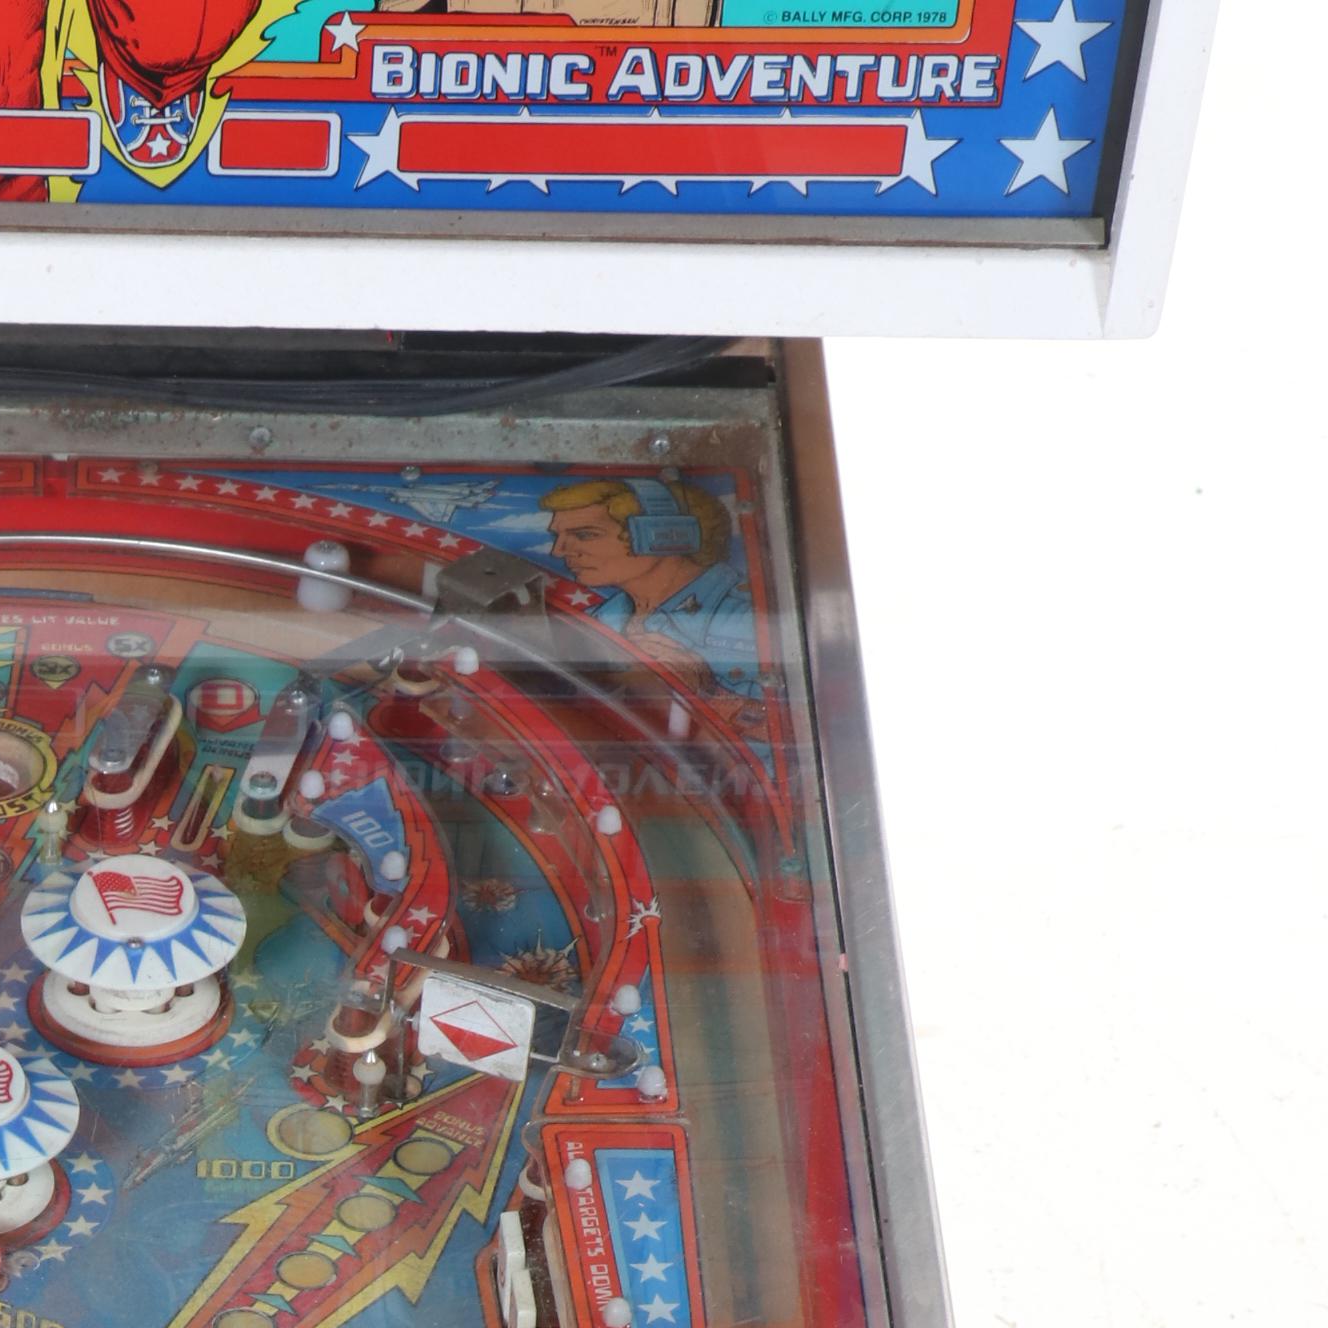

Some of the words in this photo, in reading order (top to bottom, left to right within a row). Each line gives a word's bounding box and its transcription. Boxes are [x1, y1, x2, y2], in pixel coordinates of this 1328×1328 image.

[781, 11, 826, 23] BALLY
[830, 11, 867, 23] MFG.
[871, 12, 912, 23] CORP.
[917, 12, 947, 23] 1978
[64, 615, 121, 626] VALUE
[341, 811, 393, 848] 100
[196, 1159, 294, 1180] 1000
[578, 1187, 605, 1257] TARGETS
